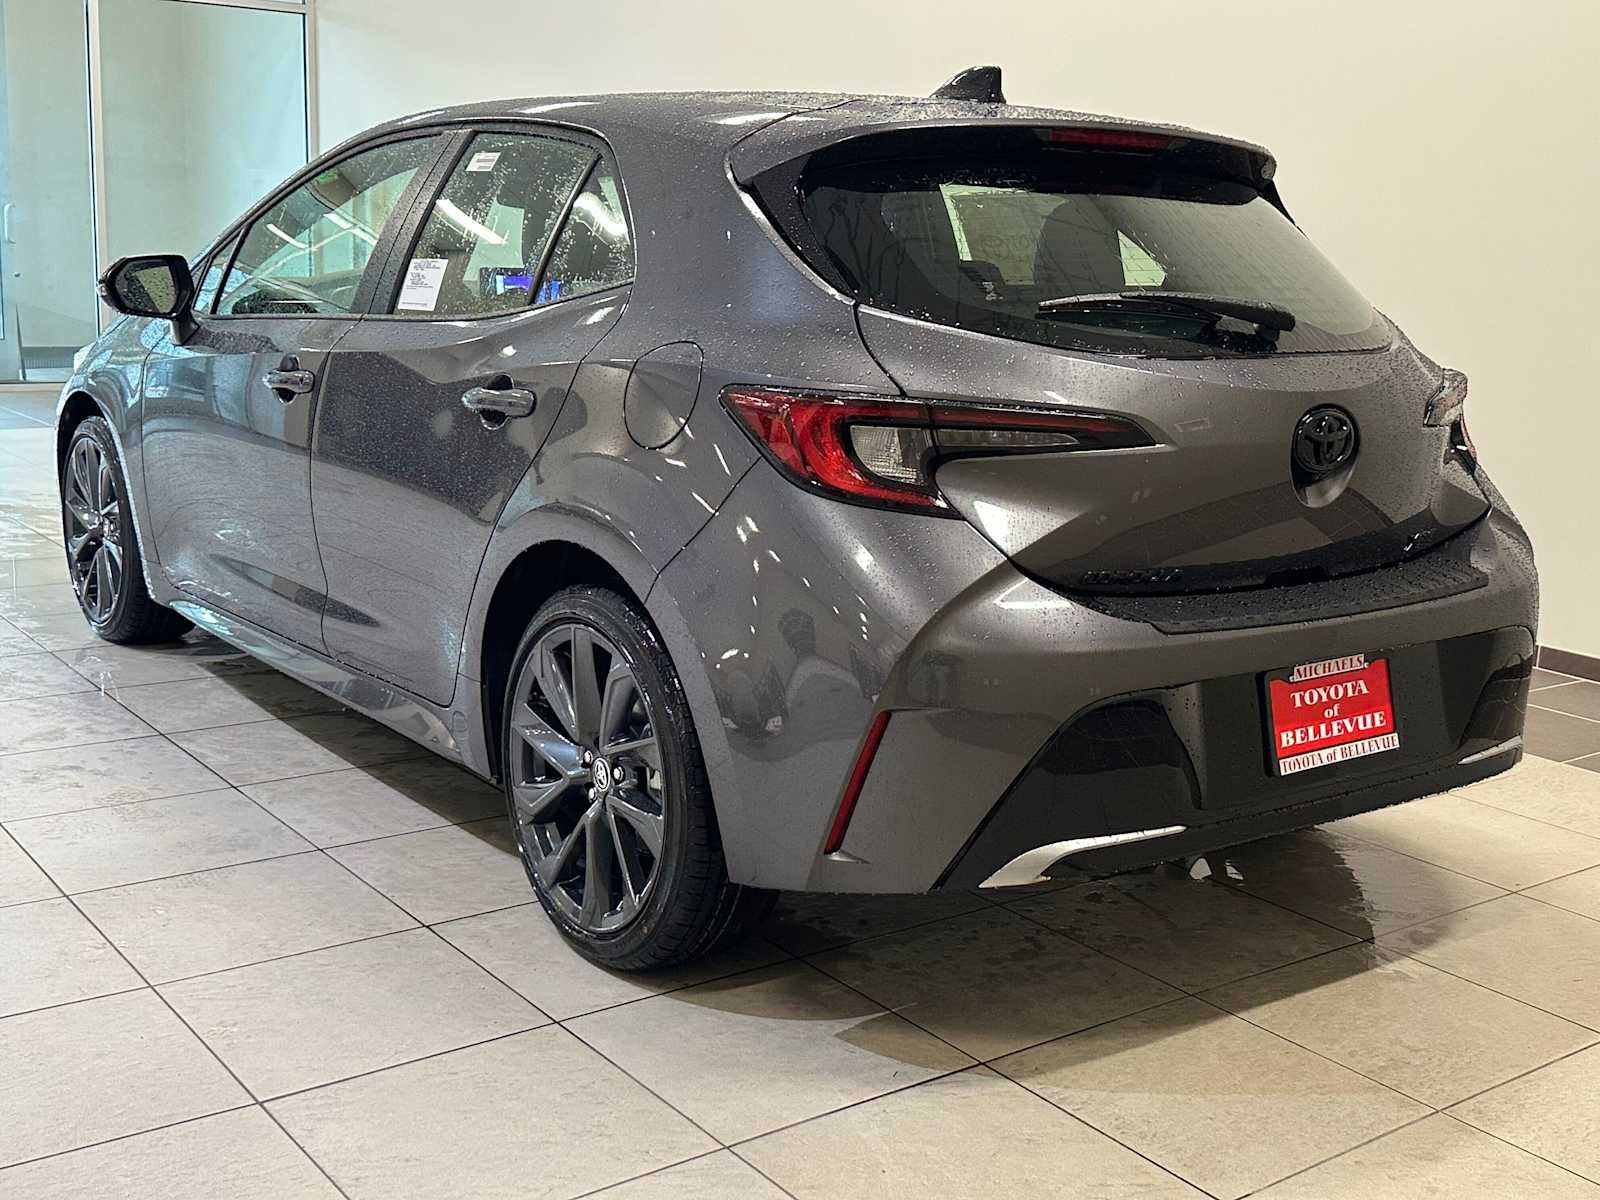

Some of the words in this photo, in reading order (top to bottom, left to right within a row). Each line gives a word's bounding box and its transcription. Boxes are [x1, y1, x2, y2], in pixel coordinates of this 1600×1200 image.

[1295, 656, 1363, 679] MICHAELS
[1290, 680, 1369, 708] TOYOTA
[1324, 703, 1341, 718] of
[1280, 711, 1387, 748] BELLEVUE
[1281, 752, 1324, 773] TOYOTA
[1326, 750, 1338, 762] of
[1340, 735, 1397, 759] BELLEVUE
